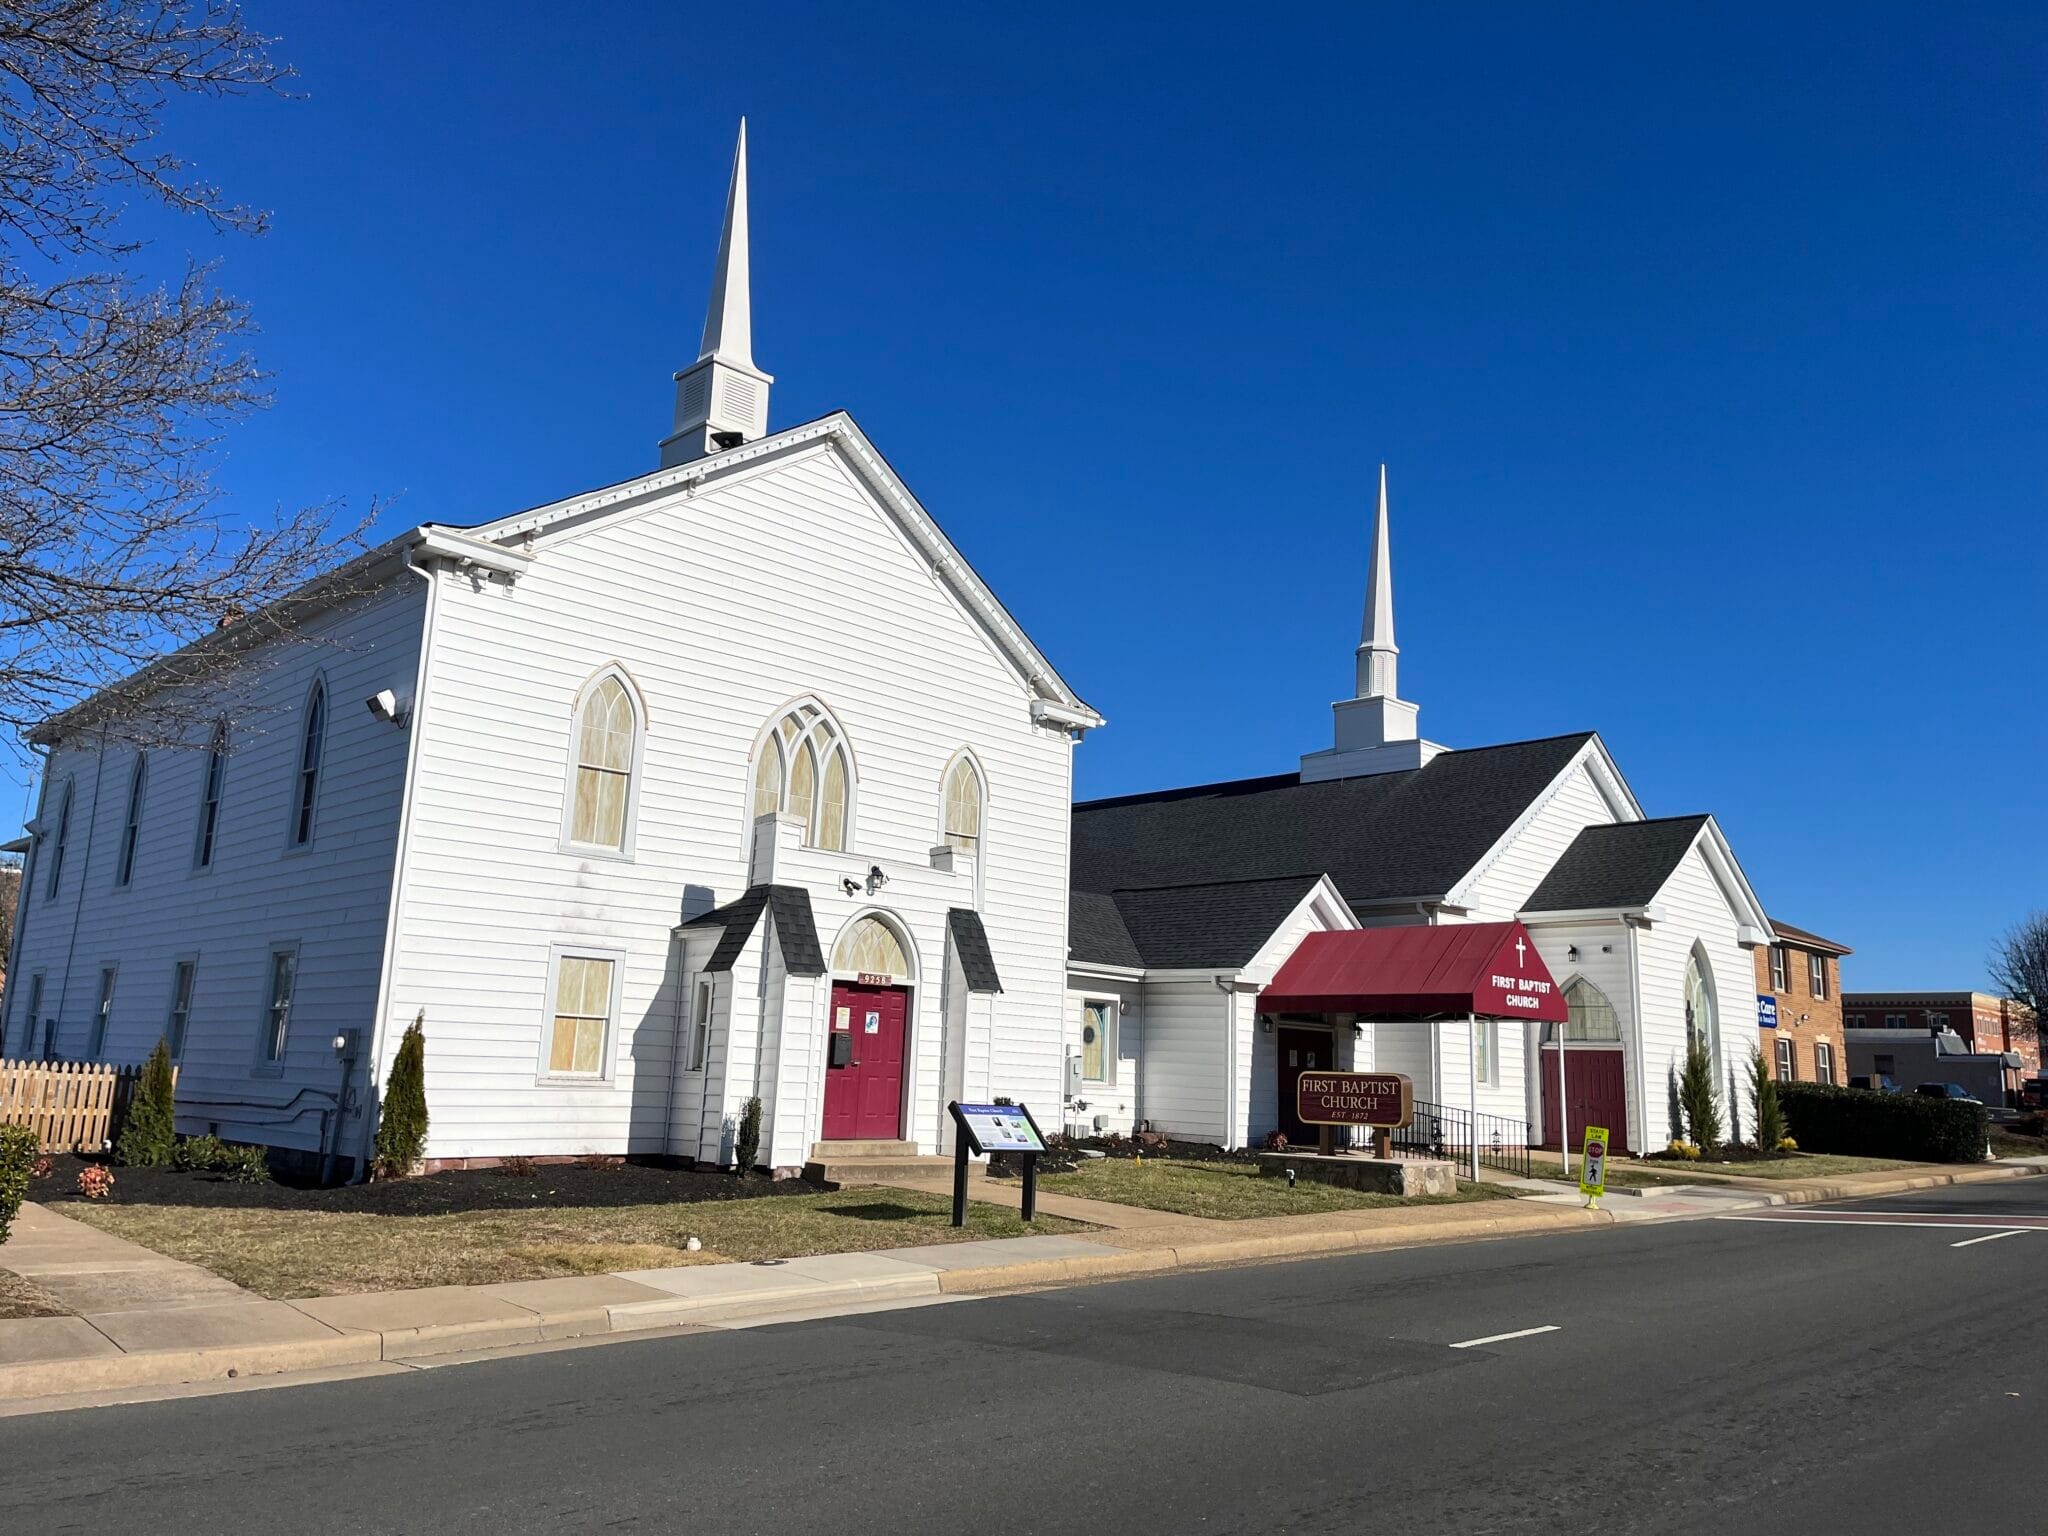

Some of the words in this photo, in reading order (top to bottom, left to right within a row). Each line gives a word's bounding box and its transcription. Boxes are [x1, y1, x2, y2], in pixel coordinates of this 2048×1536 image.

[864, 974, 886, 984] 9258
[1492, 974, 1516, 990] FIRST
[1518, 979, 1550, 994] BAPTIST
[1506, 994, 1539, 1008] CHURCH
[1302, 1080, 1336, 1092] FIRST
[1342, 1080, 1398, 1094] BAPTIST
[1321, 1096, 1378, 1110] CHURCH
